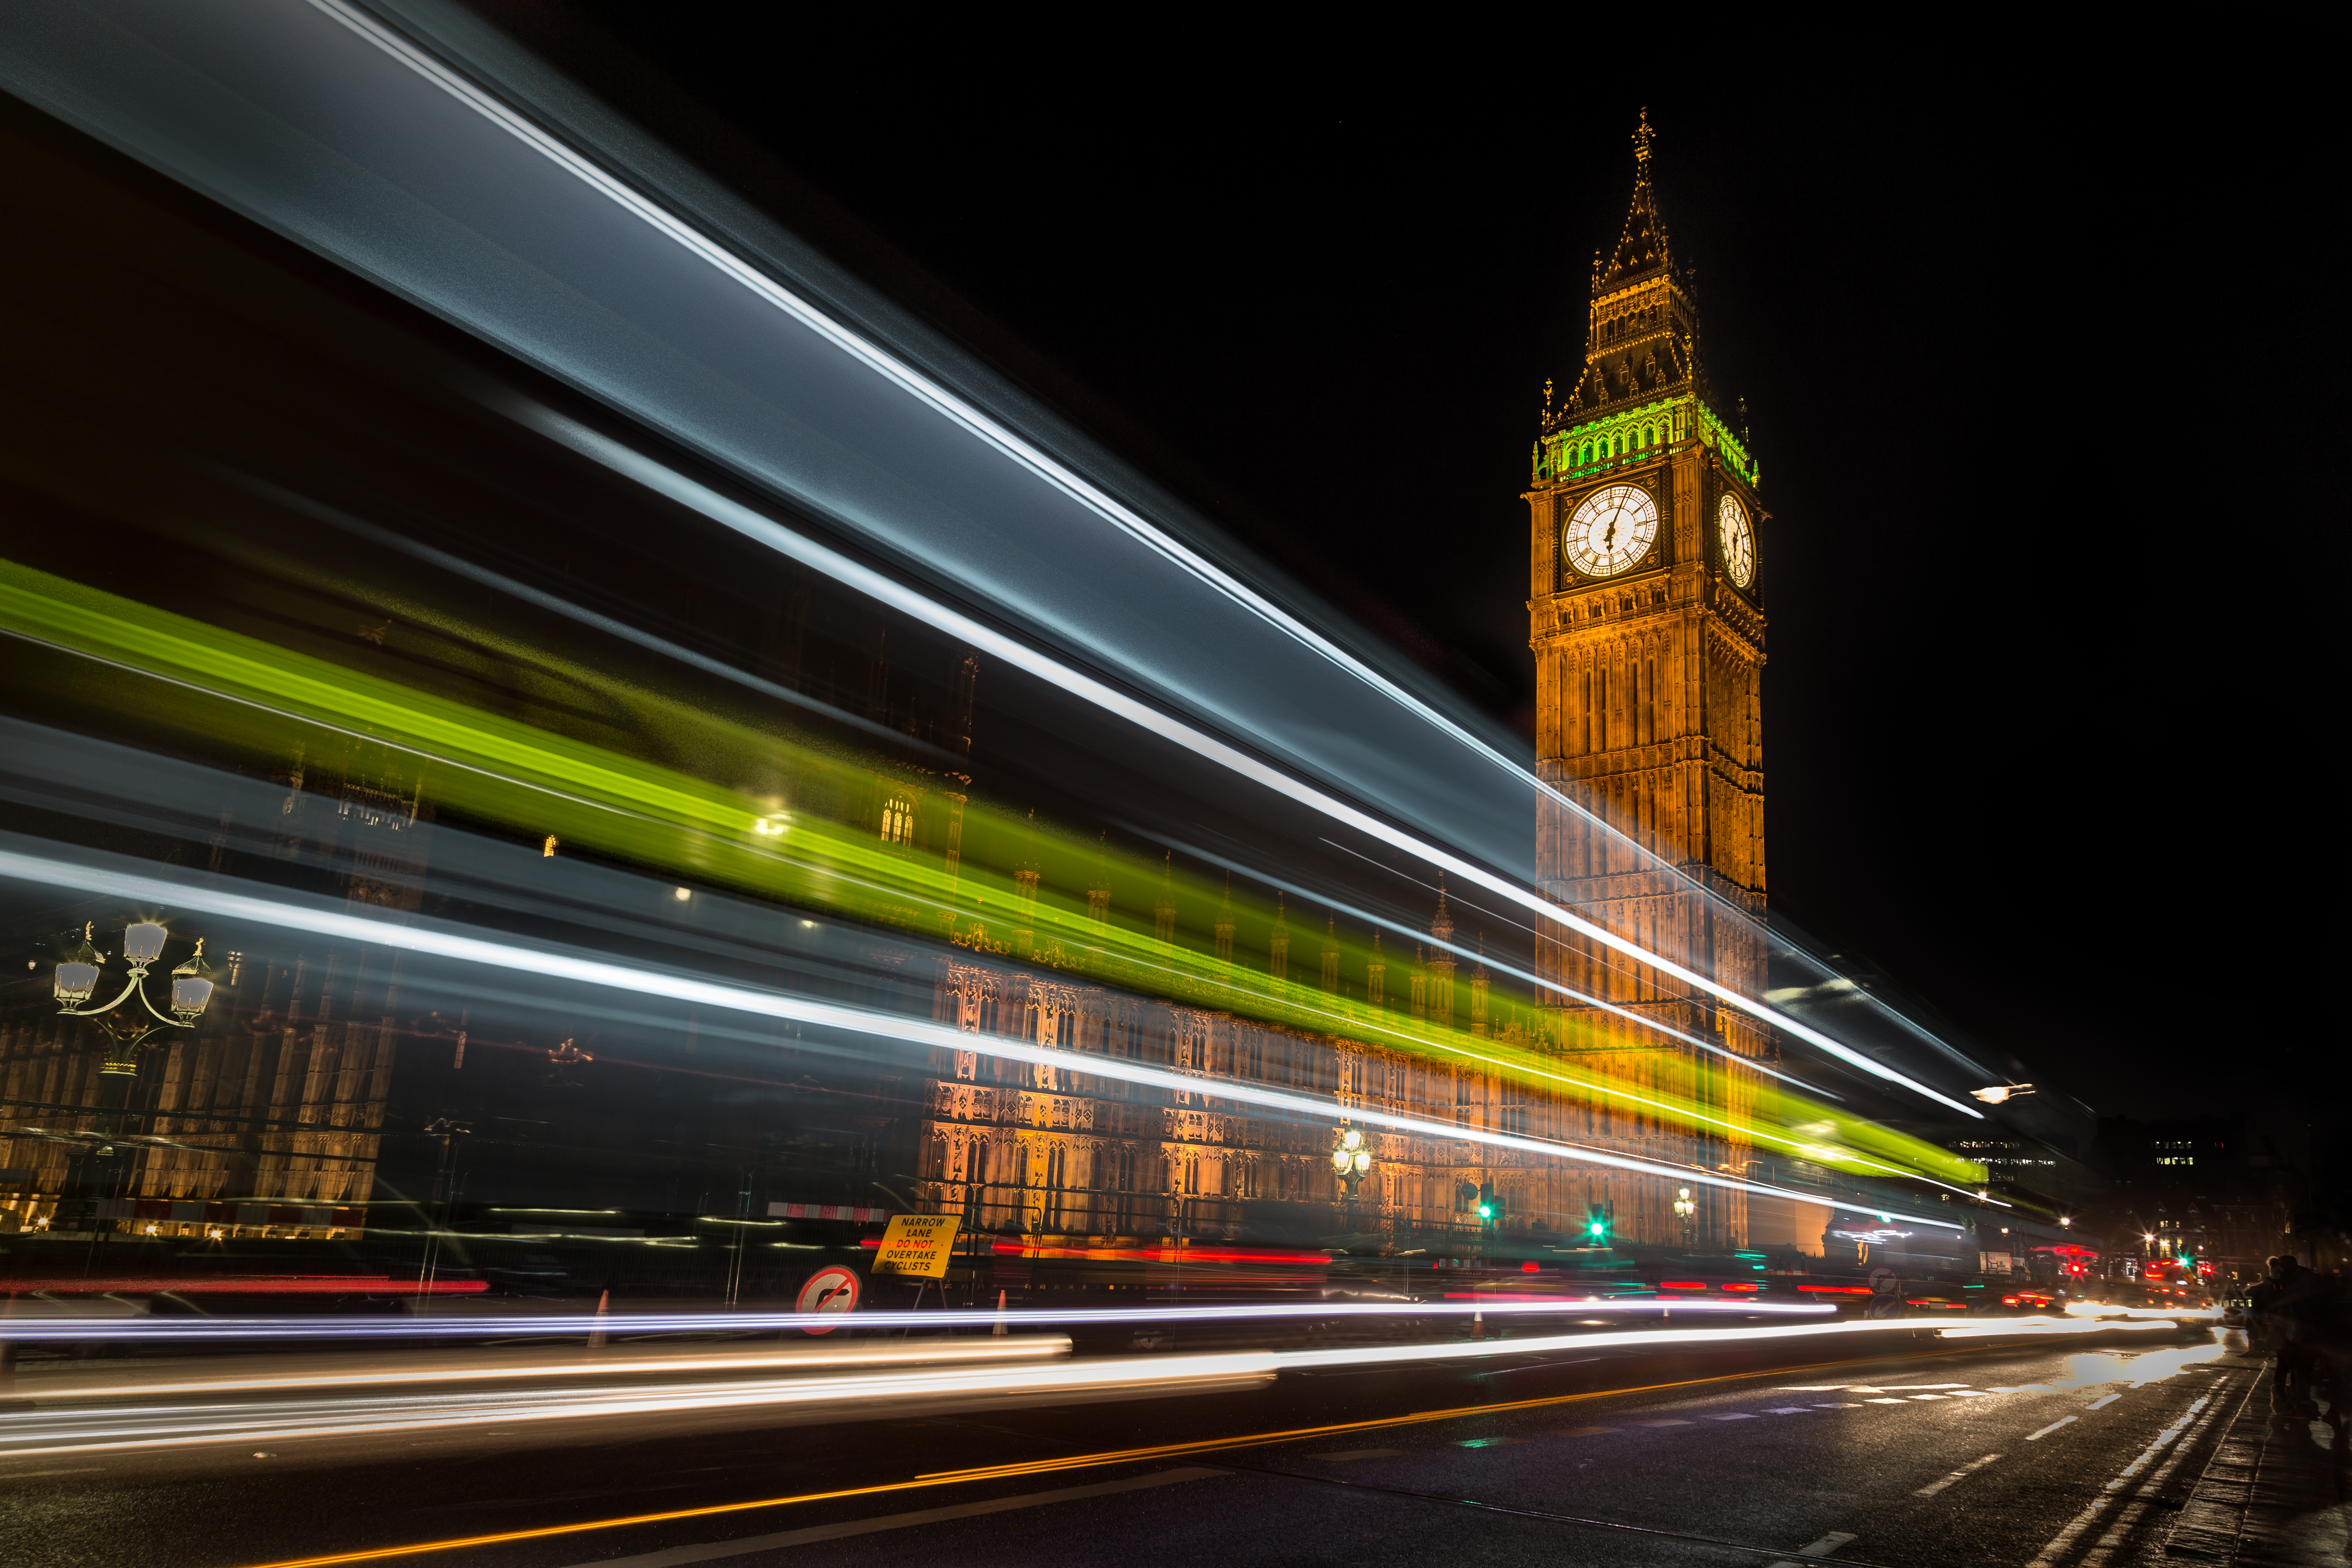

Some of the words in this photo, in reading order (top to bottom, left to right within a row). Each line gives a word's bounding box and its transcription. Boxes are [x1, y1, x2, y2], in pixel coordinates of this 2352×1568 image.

[901, 1218, 945, 1227] NARROW
[906, 1229, 932, 1237] LANE
[913, 1240, 934, 1248] NOT
[886, 1250, 937, 1259] OVERTAKE
[884, 1261, 931, 1271] CYCLISTS
